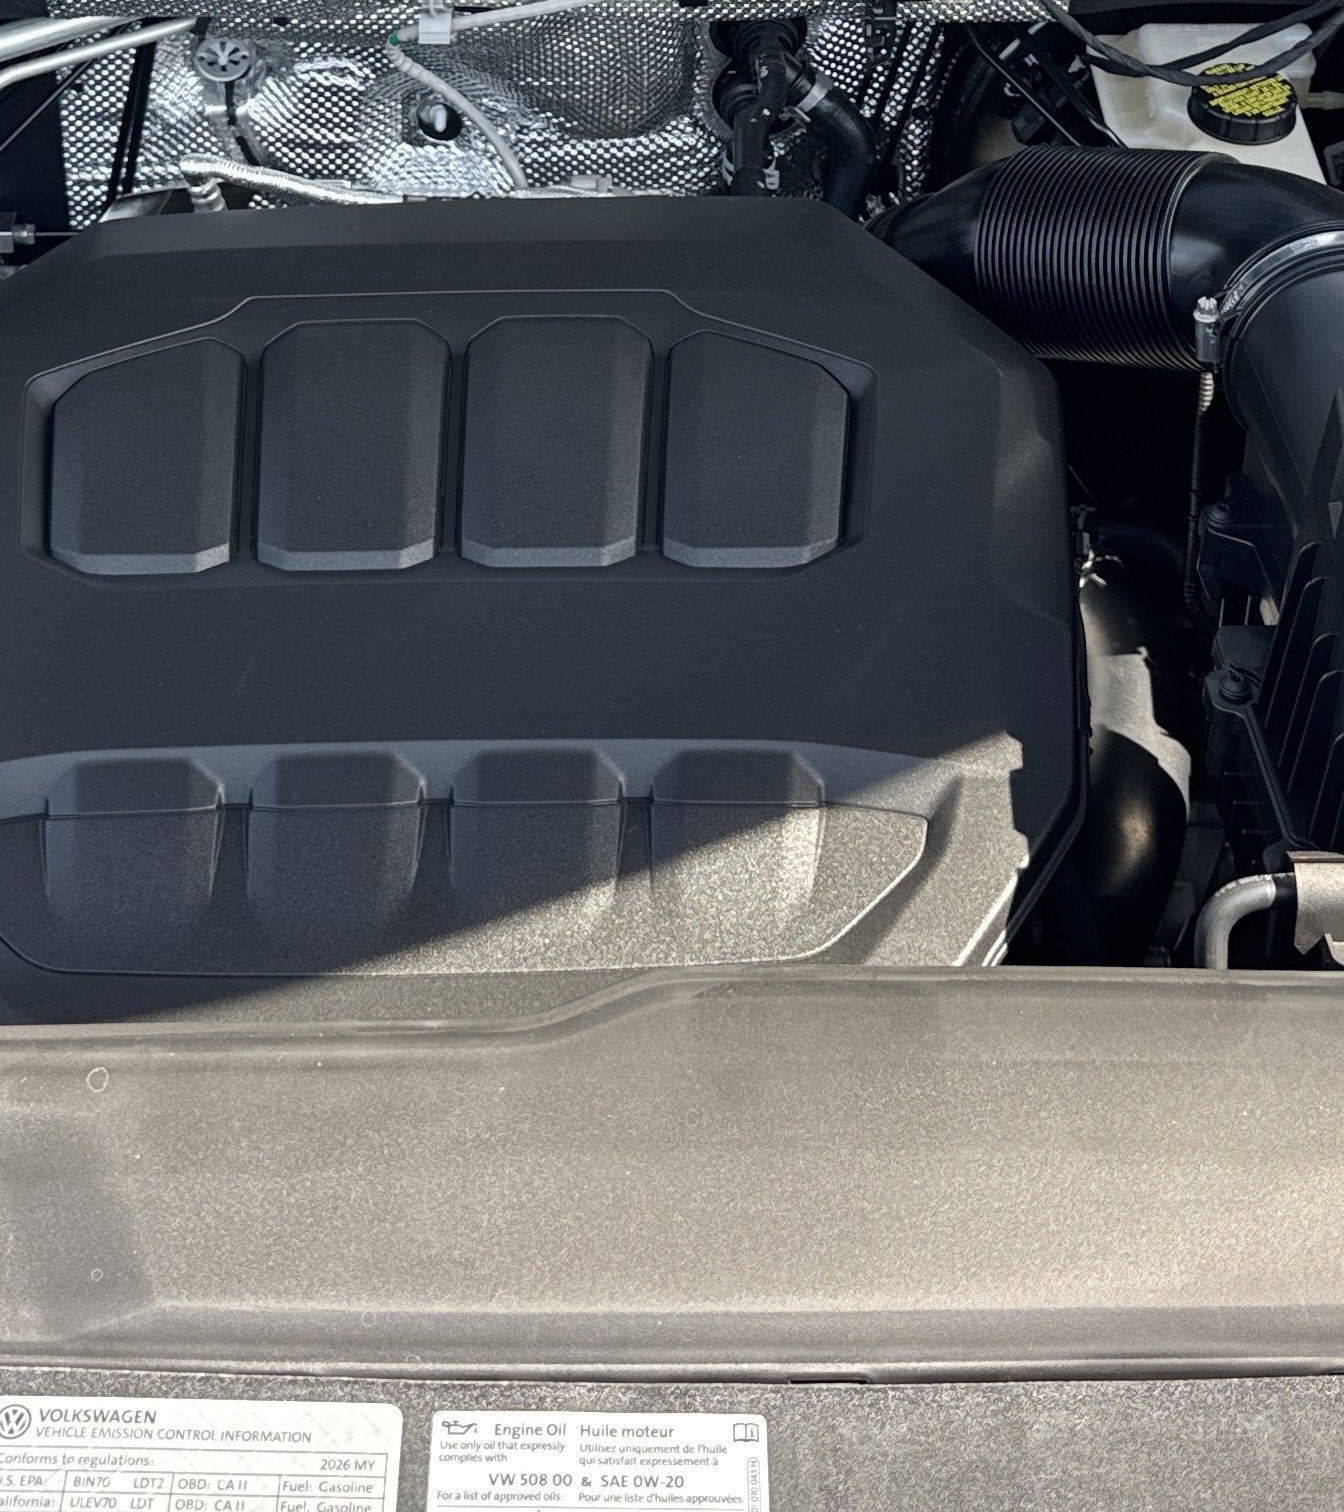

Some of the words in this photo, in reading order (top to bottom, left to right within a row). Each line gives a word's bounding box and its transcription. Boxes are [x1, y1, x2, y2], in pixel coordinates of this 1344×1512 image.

[39, 1408, 156, 1424] VOLKSWAGEN
[36, 1426, 87, 1439] VEHICLE
[90, 1427, 154, 1440] EMISSION
[157, 1429, 216, 1442] CONTROL
[219, 1429, 312, 1444] INFORMATION
[494, 1423, 543, 1440] Engine
[546, 1423, 567, 1437] Oil
[580, 1424, 618, 1438] Huile
[621, 1426, 674, 1438] moteur
[440, 1440, 458, 1450] Use
[460, 1440, 481, 1452] only
[483, 1440, 496, 1451] oil
[498, 1441, 518, 1451] that
[520, 1441, 566, 1455] expressly
[579, 1443, 617, 1453] Utilisez
[619, 1444, 680, 1456] uniquement
[682, 1444, 696, 1454] de
[697, 1443, 728, 1455] l'huile
[62, 1453, 75, 1466] to
[78, 1454, 154, 1470] regulations:
[320, 1459, 351, 1472] 2026
[354, 1460, 376, 1472] MY
[438, 1452, 483, 1464] complies
[485, 1453, 508, 1463] with
[578, 1455, 596, 1467] qui
[598, 1455, 637, 1466] satisfait
[639, 1456, 709, 1468] expressément
[73, 1476, 112, 1488] BIN70
[134, 1477, 165, 1489] LDT2
[177, 1478, 211, 1491] OBD:
[217, 1479, 235, 1491] CA
[282, 1480, 313, 1493] Fuel:
[318, 1481, 374, 1494] Gasoline
[488, 1473, 516, 1486] VW
[520, 1473, 548, 1486] 508
[552, 1474, 573, 1486] 00
[581, 1476, 592, 1487] &
[600, 1474, 629, 1488] SAE
[633, 1475, 685, 1489] 0W-20
[70, 1496, 118, 1509] ULEV70
[130, 1497, 155, 1509] LDT
[214, 1499, 232, 1511] CA
[316, 1501, 373, 1512] Gasoline
[437, 1490, 453, 1501] For
[455, 1492, 461, 1500] a
[463, 1491, 479, 1501] list
[481, 1490, 492, 1501] of
[494, 1491, 541, 1503] approved
[578, 1492, 601, 1502] Pour
[603, 1494, 623, 1502] une
[624, 1493, 644, 1502] liste
[646, 1492, 684, 1503] d'huiles
